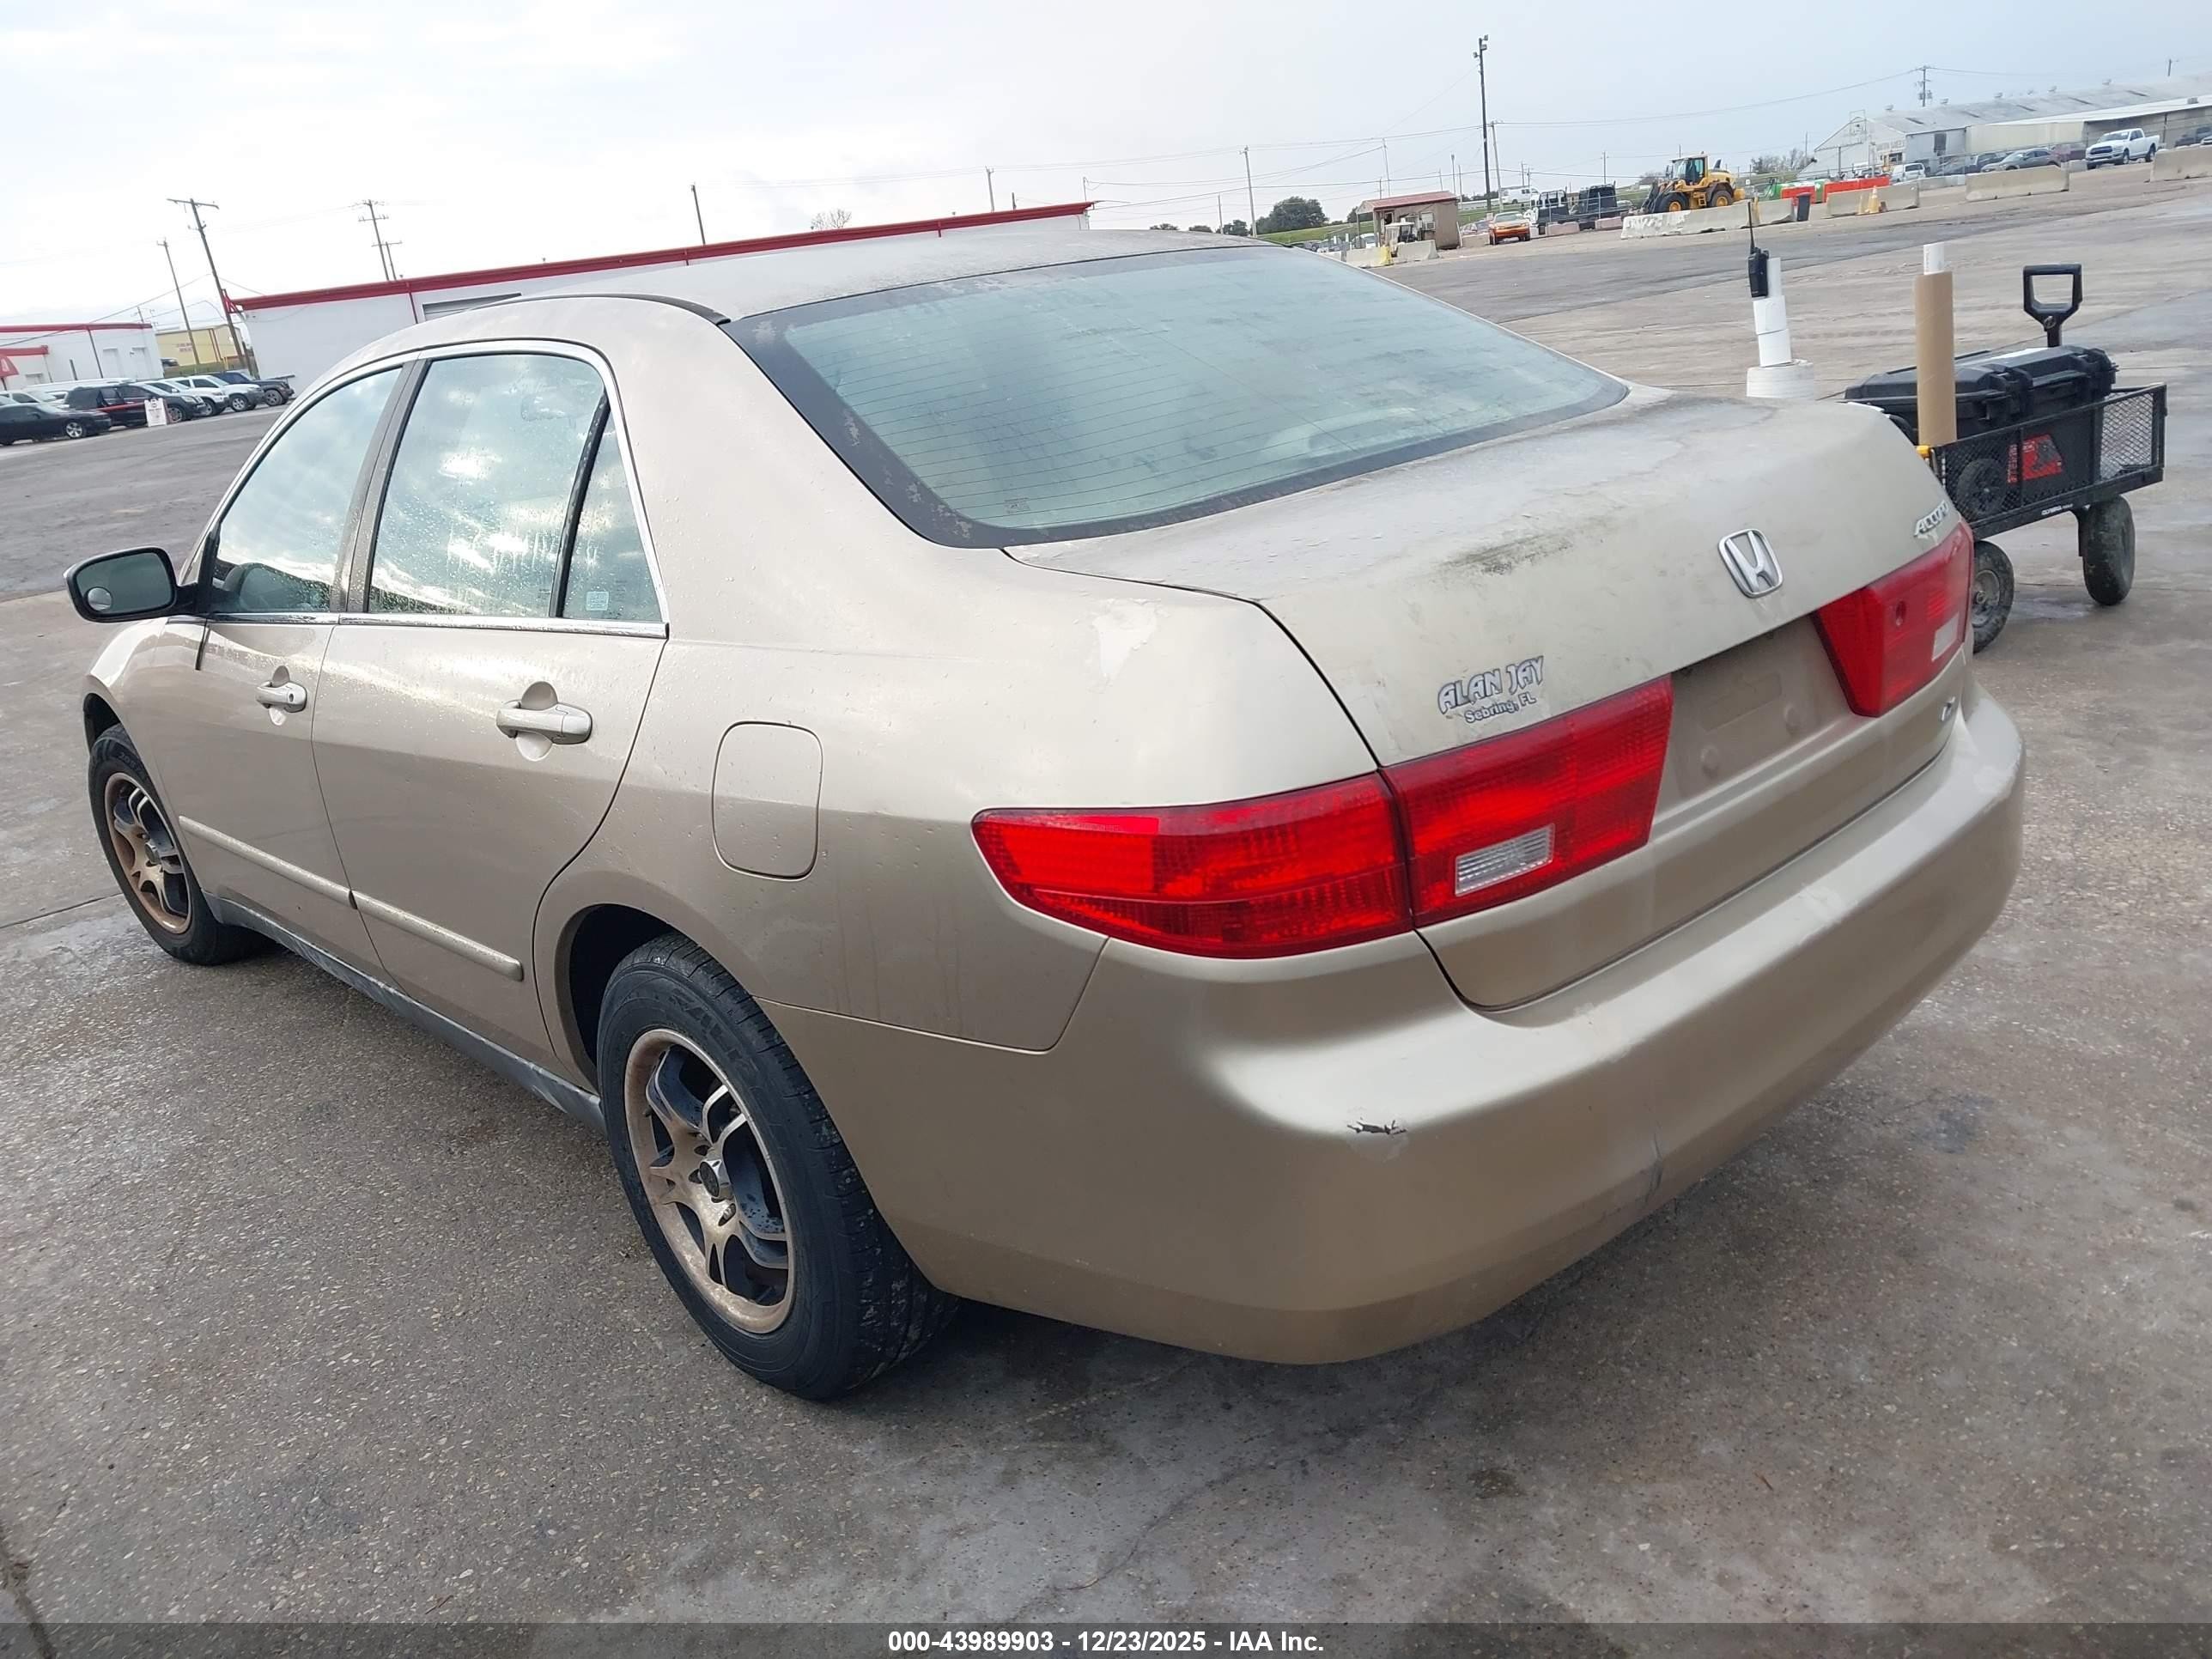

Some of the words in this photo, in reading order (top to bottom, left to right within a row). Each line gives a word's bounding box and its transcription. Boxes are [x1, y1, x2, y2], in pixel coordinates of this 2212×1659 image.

[1437, 668, 1503, 714] ALAN
[1506, 655, 1544, 695] JAY
[1464, 700, 1518, 724] Sebring,
[1519, 692, 1537, 707] FL
